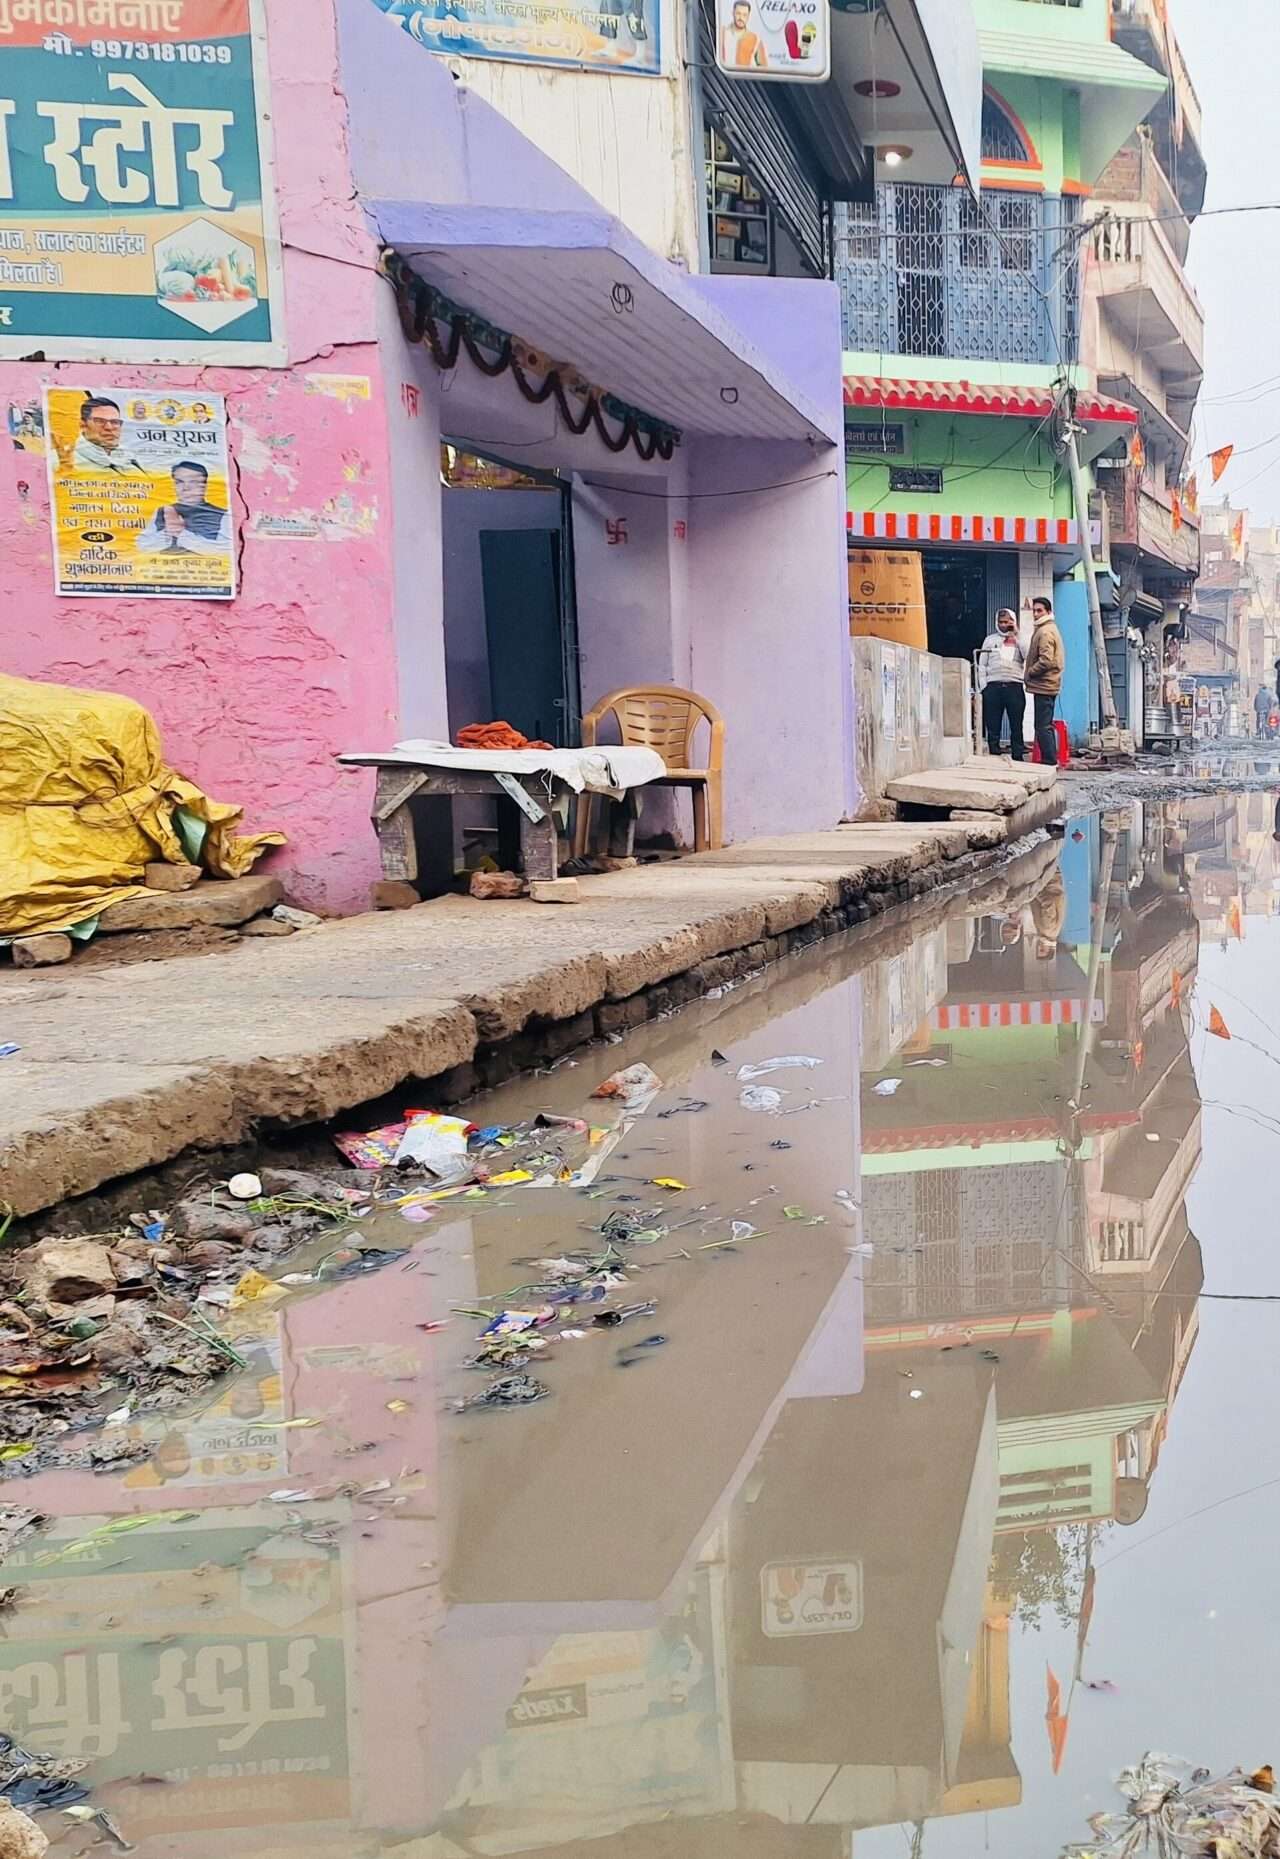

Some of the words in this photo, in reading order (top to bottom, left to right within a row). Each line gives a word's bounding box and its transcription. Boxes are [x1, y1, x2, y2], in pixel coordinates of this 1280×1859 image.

[760, 0, 816, 14] RELAXO
[91, 40, 232, 64] 9973181039
[37, 72, 235, 210] स्टोर
[172, 430, 217, 448] सुराज
[849, 596, 907, 615] eecon
